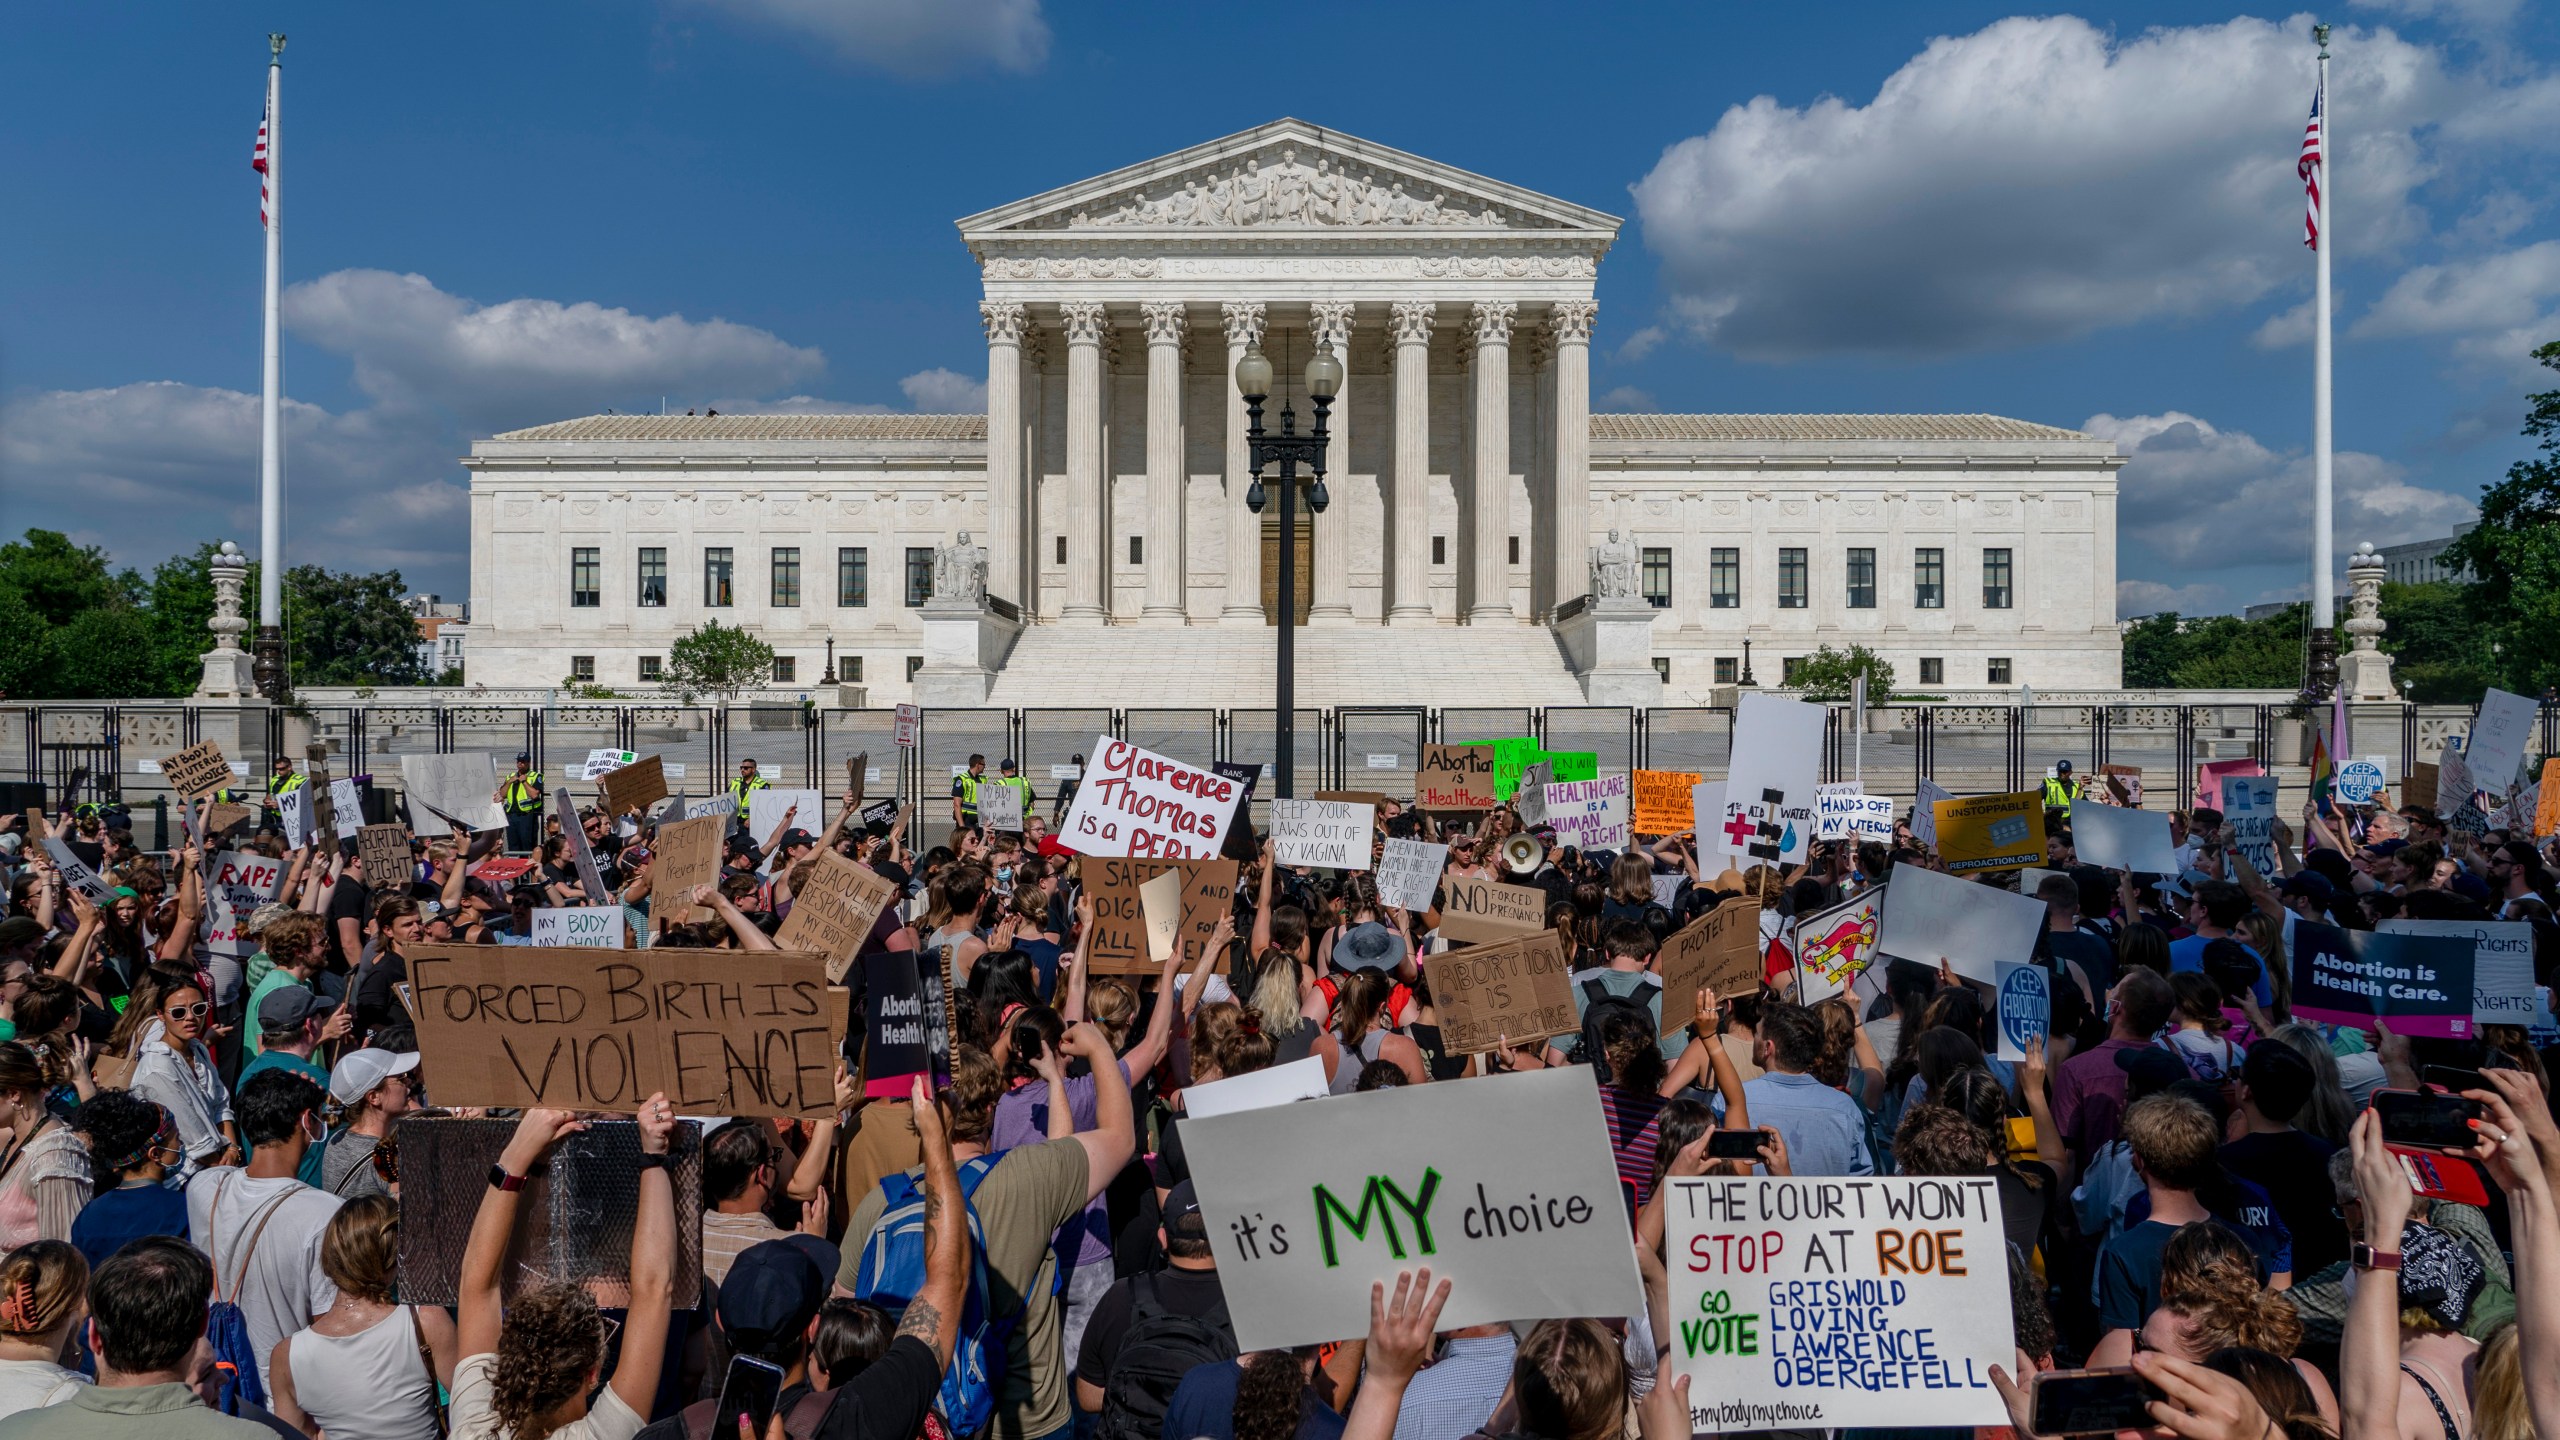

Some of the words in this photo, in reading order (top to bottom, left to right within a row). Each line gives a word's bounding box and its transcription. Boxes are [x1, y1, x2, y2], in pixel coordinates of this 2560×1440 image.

[1173, 262, 1229, 274] EQUAL
[1235, 262, 1298, 274] JUSTICE
[1310, 262, 1364, 274] UNDER
[1371, 262, 1405, 274] LAW
[898, 716, 914, 724] PARKING
[903, 707, 911, 715] NO
[162, 758, 178, 772] MY
[587, 760, 599, 768] AID
[600, 760, 613, 768] AND
[613, 761, 629, 770] ABE
[606, 752, 620, 760] WILL
[1427, 748, 1494, 772] Abortion
[169, 770, 185, 783] MY
[185, 752, 223, 775] UTERUS
[1104, 741, 1232, 803] Clarence
[1223, 769, 1243, 778] BANS
[1452, 772, 1464, 784] is
[2349, 764, 2375, 775] KEEP
[177, 780, 194, 796] MY
[192, 763, 230, 786] CHOICE
[2342, 774, 2380, 787] ABORTION
[281, 793, 297, 812] MY
[984, 786, 993, 799] MY
[995, 786, 1011, 801] BODY
[987, 800, 997, 808] NOT
[1427, 788, 1494, 807] Healthcare
[1648, 799, 1662, 807] NOT
[1965, 797, 1999, 806] ABORTION
[864, 804, 890, 819] ABORTION
[1096, 777, 1217, 840] Thomas
[1271, 801, 1310, 820] KEEP
[1317, 803, 1352, 820] YOUR
[1588, 803, 1597, 811] IS
[1600, 800, 1608, 810] A
[1748, 809, 1764, 819] AID
[1781, 807, 1811, 821] WATER
[1820, 797, 1863, 814] HANDS
[1868, 800, 1891, 814] OFF
[1947, 801, 2029, 818] UNSTOPPABLE
[1078, 810, 1097, 835] is
[1101, 825, 1118, 841] a
[1270, 823, 1308, 839] LAWS
[1314, 824, 1340, 839] OUT
[1345, 827, 1361, 842] OF
[1550, 814, 1601, 832] HUMAN
[1822, 817, 1843, 833] MY
[1848, 818, 1892, 834] UTERUS
[2260, 817, 2273, 837] NOT
[358, 828, 409, 850] ABORTION
[659, 821, 724, 857] VASECTOMY
[1582, 825, 1624, 846] RIGHT
[373, 849, 387, 860] IS
[388, 850, 396, 858] A
[1274, 843, 1295, 860] MY
[1301, 844, 1347, 864] VAGINA
[1386, 840, 1411, 855] WHEN
[1414, 843, 1430, 859] WILL
[364, 856, 410, 882] RIGHT
[665, 856, 711, 882] Prevents
[1381, 856, 1406, 873] WOMEN
[1427, 861, 1440, 875] THE
[1950, 854, 2038, 870] REPROACTION.ORG
[217, 863, 280, 888] RAPE
[1377, 870, 1401, 888] SAME
[1404, 874, 1433, 893] RIGHTS
[652, 886, 694, 914] Abortio
[812, 862, 887, 917] EJACULATE
[1200, 884, 1229, 899] AND
[1390, 890, 1420, 908] GUNS?
[1450, 882, 1488, 914] NO
[1490, 889, 1533, 906] FORCED
[538, 916, 556, 930] MY
[568, 914, 610, 934] BODY
[801, 882, 873, 944] RESPONSIBLY
[803, 914, 820, 933] MY
[1490, 904, 1543, 923] PREGNANCY
[538, 935, 559, 947] MY
[566, 936, 614, 947] CHOICE
[794, 932, 812, 951] MY
[1094, 931, 1136, 952] ALL
[1680, 909, 1739, 959] PROTECT
[2474, 928, 2529, 953] RIGHTS
[1438, 947, 1565, 992] ABORTION
[1668, 959, 1706, 990] Griswold
[1696, 957, 1731, 989] Lawrence
[2312, 952, 2402, 979] Abortion
[2407, 964, 2436, 981] is
[413, 957, 584, 1023] FORCED
[599, 963, 742, 1024] BIRTH
[753, 981, 820, 1017] IS
[2012, 970, 2041, 994] KEEP
[2312, 970, 2383, 998] Health
[2387, 980, 2448, 1003] Care.
[881, 995, 920, 1018] Abortio
[1484, 984, 1512, 1009] IS
[2004, 992, 2049, 1020] ABORTION
[2474, 985, 2534, 1013] RIGHTS
[881, 1022, 921, 1046] Health
[1443, 1004, 1572, 1049] HEALTHCARE
[502, 1026, 835, 1110] VIOLENCE
[1674, 1181, 1747, 1222] THE
[1758, 1180, 1873, 1223] COURT
[1888, 1180, 1995, 1223] WON'T
[1232, 1211, 1289, 1263] it's
[1312, 1166, 1442, 1268] MY
[1463, 1182, 1593, 1241] choice
[1688, 1230, 1784, 1274] STOP
[1805, 1229, 1854, 1274] AT
[1876, 1228, 1967, 1276] ROE
[1701, 1290, 1730, 1314] GO
[1769, 1280, 1906, 1307] GRISWOLD
[1771, 1306, 1889, 1332] LOVING
[1681, 1313, 1759, 1358] VOTE
[1772, 1329, 1937, 1360] LAWRENCE
[1774, 1356, 1987, 1391] OBERGEFELL
[1689, 1397, 1823, 1427] #mybodymychoice
